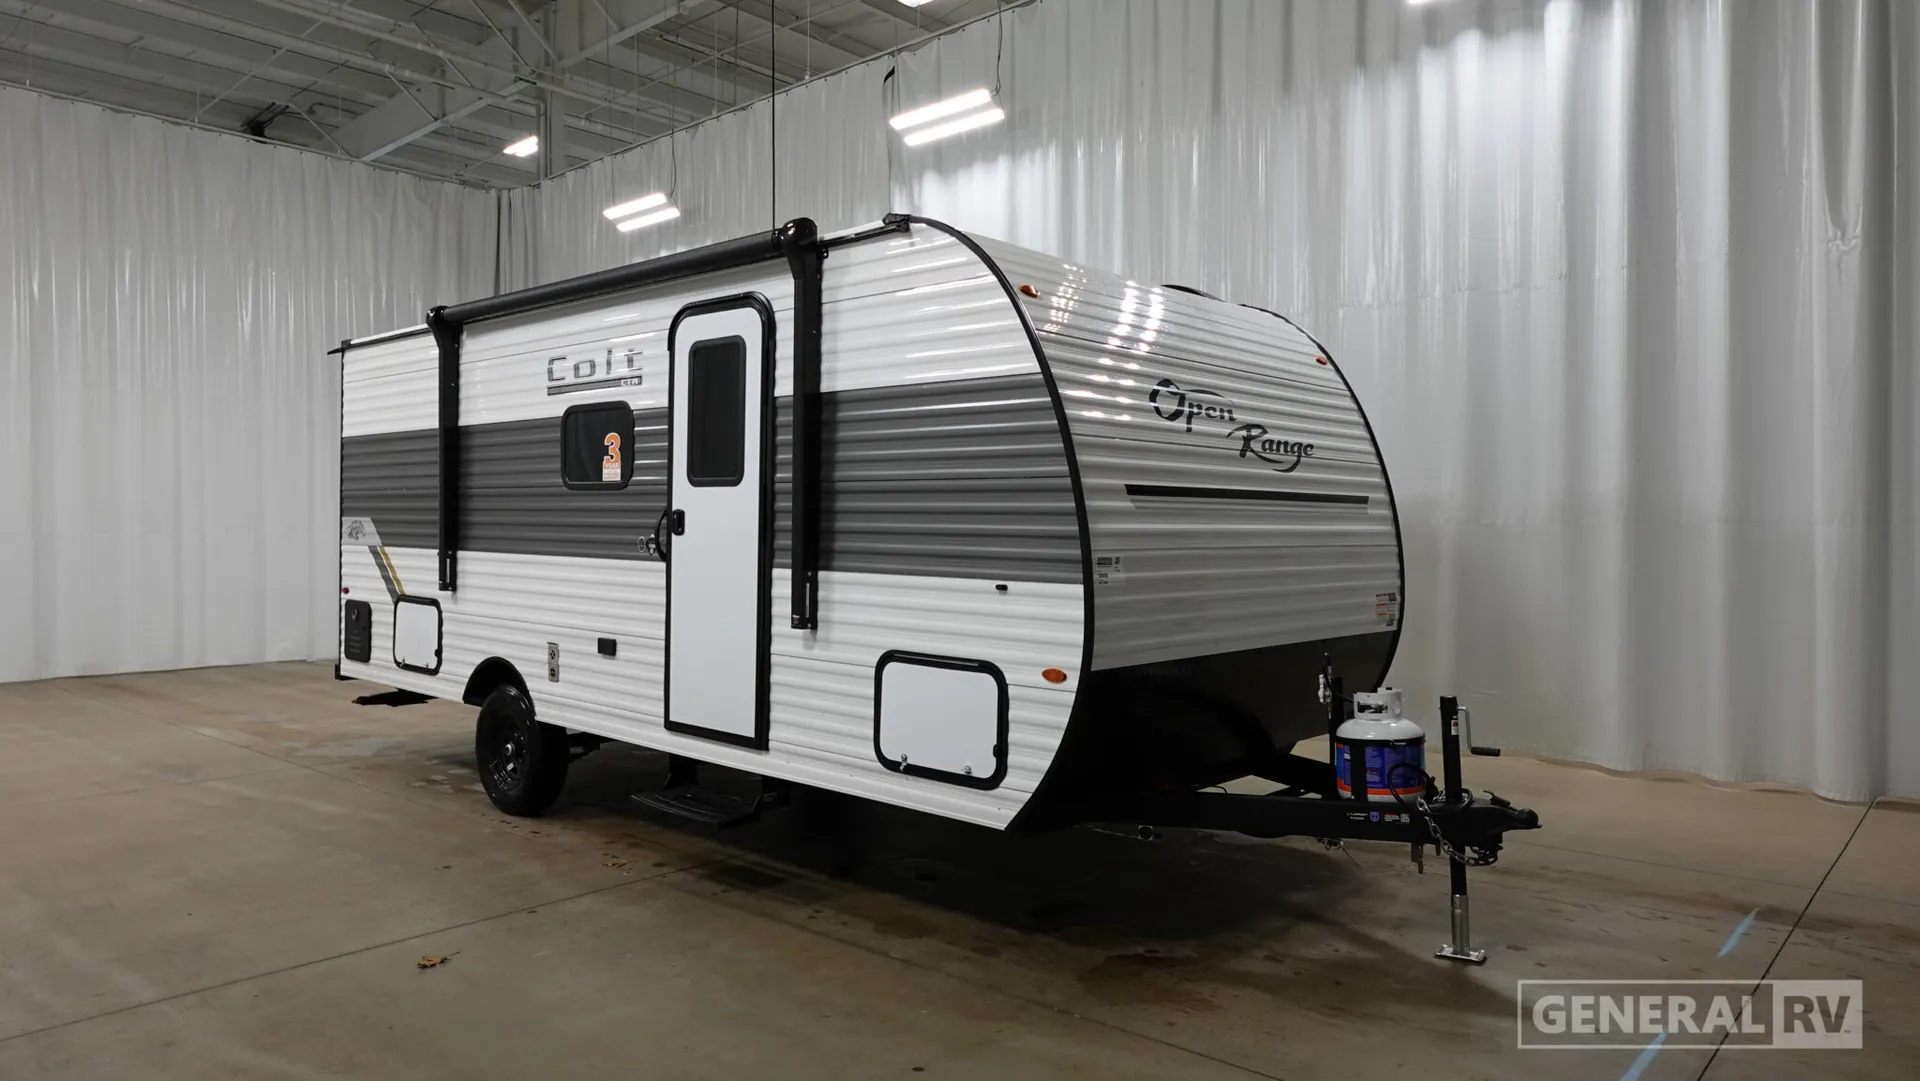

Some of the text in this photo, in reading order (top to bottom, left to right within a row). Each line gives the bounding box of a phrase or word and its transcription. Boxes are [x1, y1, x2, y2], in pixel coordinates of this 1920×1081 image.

[548, 349, 643, 381] Colt
[1149, 378, 1237, 433] Open
[604, 432, 621, 464] 3
[1226, 423, 1315, 473] Range
